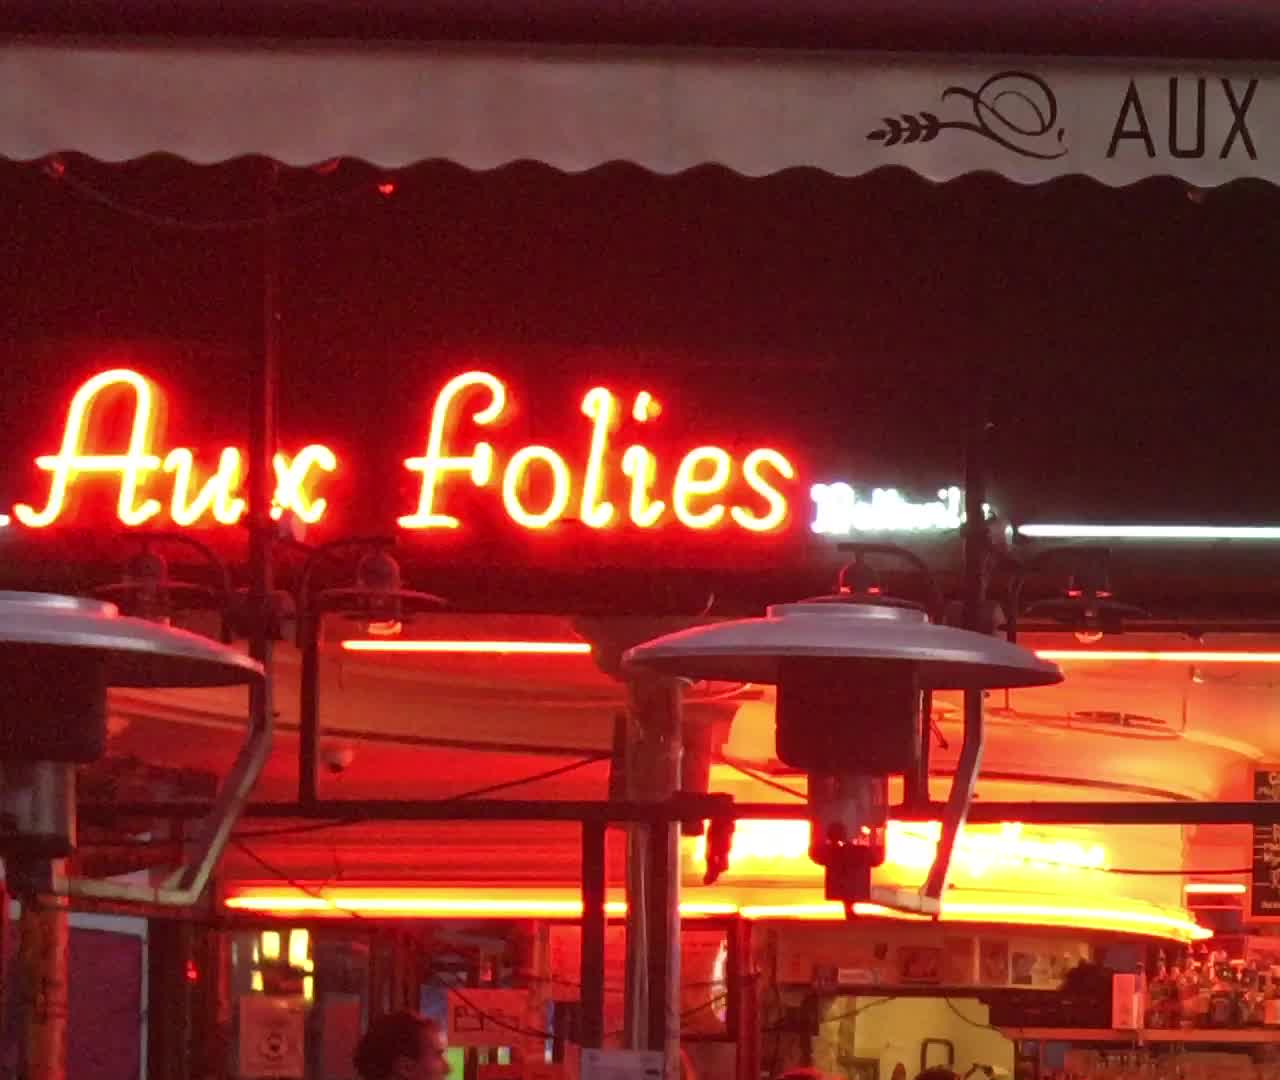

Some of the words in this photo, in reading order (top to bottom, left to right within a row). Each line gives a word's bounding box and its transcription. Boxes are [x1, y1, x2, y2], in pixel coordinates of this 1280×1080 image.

[1105, 78, 1258, 160] AUX
[14, 368, 338, 530] Aux
[397, 370, 797, 531] folies
